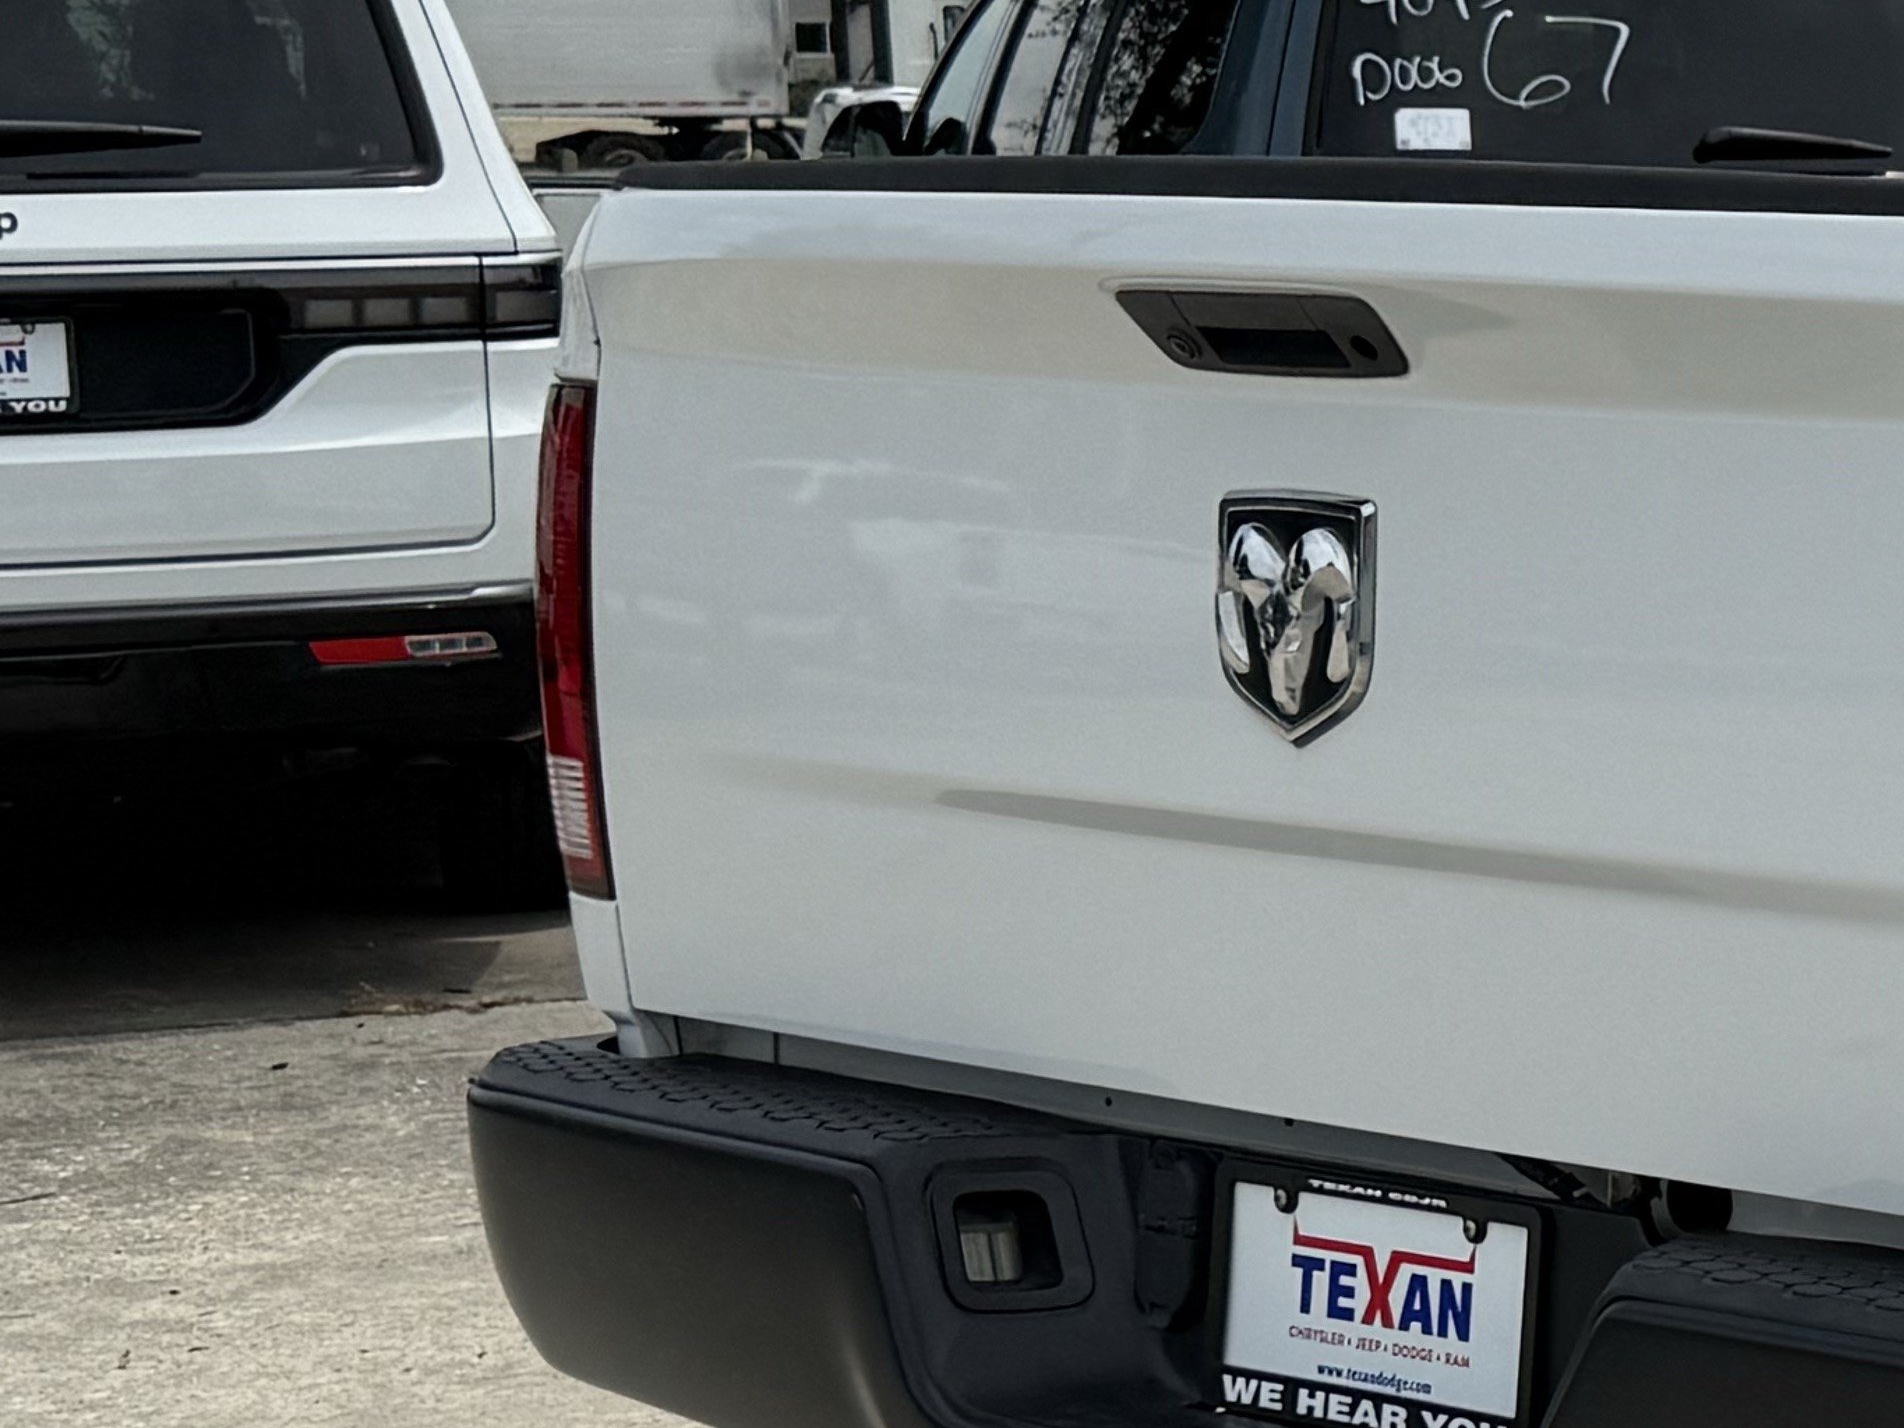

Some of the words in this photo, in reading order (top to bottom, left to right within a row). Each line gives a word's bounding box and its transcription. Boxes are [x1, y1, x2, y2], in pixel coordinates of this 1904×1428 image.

[1484, 9, 1631, 109] 67
[10, 399, 67, 414] YOU
[1308, 1178, 1383, 1199] TEXAN
[1291, 1242, 1474, 1343] TEXAN
[1289, 1325, 1346, 1347] CHRYSLER
[1354, 1336, 1381, 1353] JEEP
[1391, 1343, 1434, 1363] DODGE
[1444, 1351, 1471, 1368] RAM
[1222, 1374, 1283, 1410] WE
[1316, 1363, 1433, 1395] www.texandodge.com
